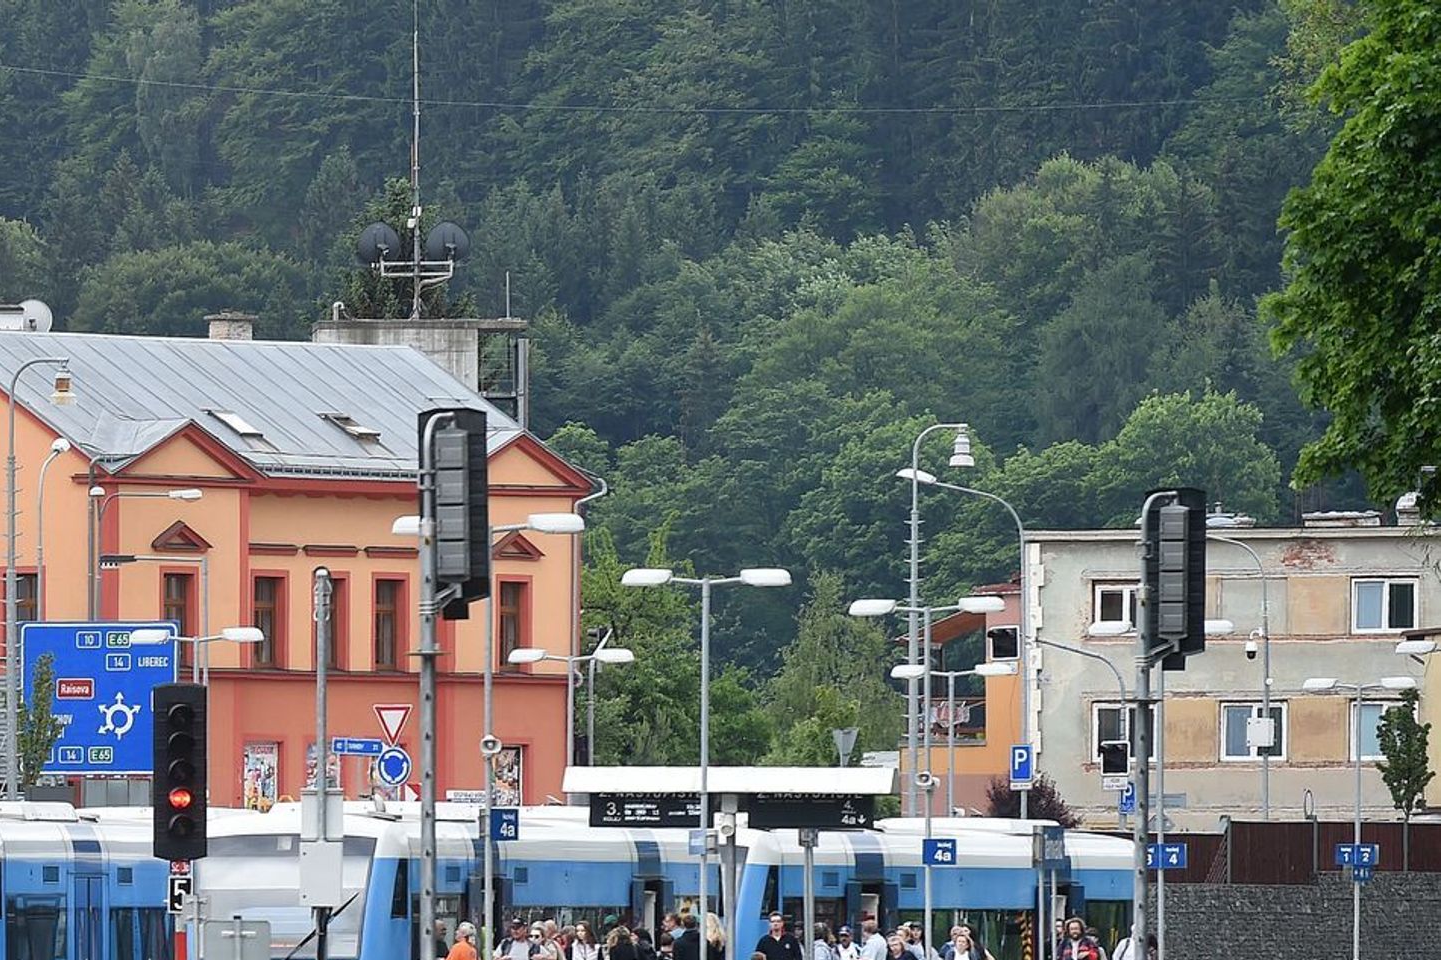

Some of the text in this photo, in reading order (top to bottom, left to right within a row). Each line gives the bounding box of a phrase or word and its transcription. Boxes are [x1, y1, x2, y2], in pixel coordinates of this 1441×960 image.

[84, 635, 94, 645] 10
[113, 656, 169, 668] 14 LIBEREC
[60, 683, 90, 695] Raisova
[66, 750, 77, 761] 14
[1014, 749, 1028, 770] P
[500, 822, 516, 837] 4a
[934, 849, 952, 862] 4a
[1168, 853, 1178, 865] 4
[1361, 852, 1369, 863] 2
[174, 879, 187, 910] 5
